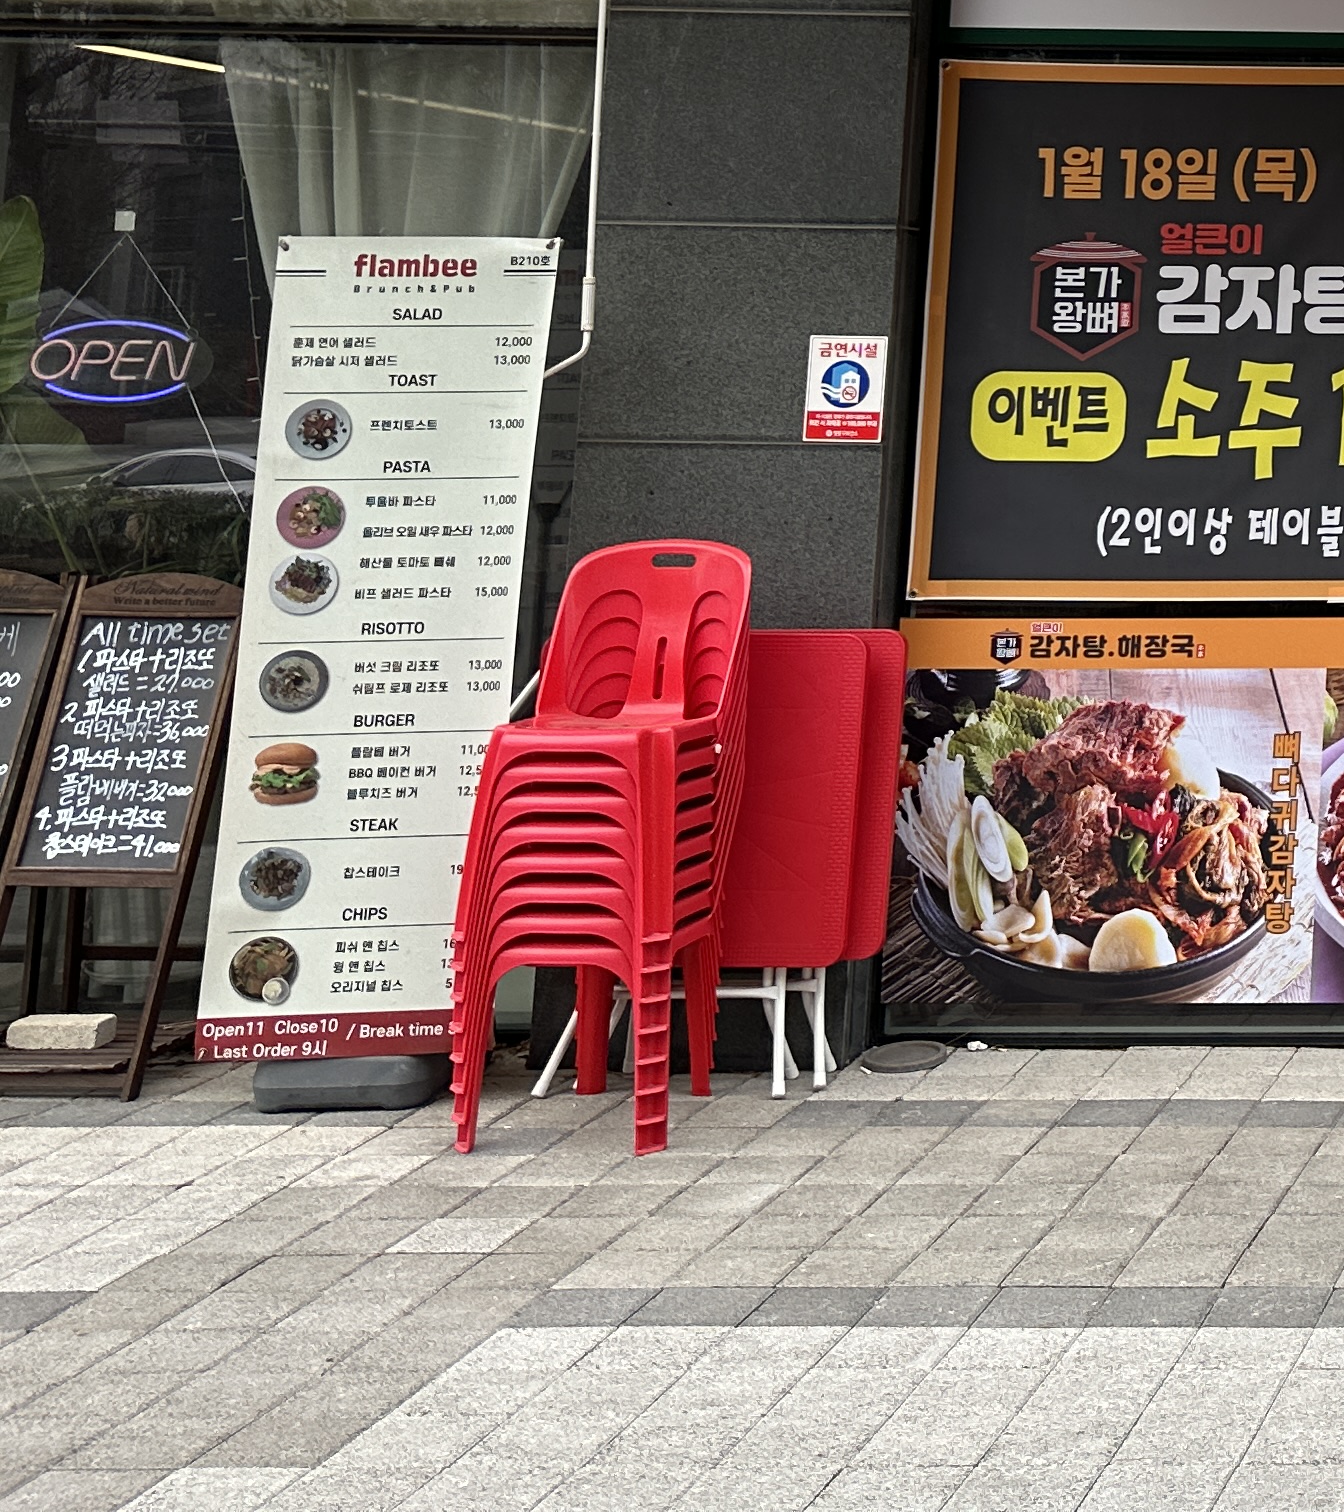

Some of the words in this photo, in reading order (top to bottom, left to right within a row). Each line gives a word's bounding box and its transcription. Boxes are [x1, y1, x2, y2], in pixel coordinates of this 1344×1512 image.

[1038, 145, 1104, 201] 1월
[1119, 147, 1218, 201] 18일
[1232, 146, 1319, 203] (목)
[1159, 222, 1264, 256] 얼큰이
[354, 253, 478, 278] flambee
[1054, 266, 1123, 298] 본가
[392, 308, 443, 321] SALAD
[1052, 301, 1120, 334] 왕뼈
[494, 336, 533, 348] 12,000
[818, 342, 878, 359] 금연시설
[30, 338, 196, 381] OPEN
[493, 354, 531, 366] 13,000
[388, 374, 438, 387] TOAST
[489, 418, 525, 430] 13,000
[987, 384, 1111, 451] 이벤트
[1145, 357, 1303, 482] 소주
[383, 460, 431, 473] PASTA
[483, 494, 518, 506] 11,000
[480, 524, 515, 537] 12,000
[1095, 505, 1235, 559] (2인이상
[477, 555, 512, 567] 12,000
[475, 586, 509, 598] 15,000
[81, 620, 122, 648] All
[127, 620, 184, 646] time
[183, 621, 232, 645] set
[361, 621, 425, 635] RISOTTO
[468, 659, 503, 671] 13,000
[466, 680, 501, 692] 13,000
[353, 713, 416, 728] BURGER
[388, 745, 411, 758] 버거
[348, 767, 373, 779] BBQ
[414, 765, 437, 778] 버거
[395, 786, 419, 799] 버거
[349, 818, 399, 832] STEAK
[1263, 730, 1302, 935] 뼈다귀감자탕
[342, 906, 388, 921] CHIPS
[377, 939, 400, 953] 칩스
[363, 960, 386, 973] 칩스
[380, 979, 404, 992] 칩스
[359, 1023, 404, 1039] Break
[408, 1021, 444, 1037] time
[213, 1044, 248, 1059] Last
[252, 1043, 298, 1058] Order
[301, 1040, 328, 1056] 9시
